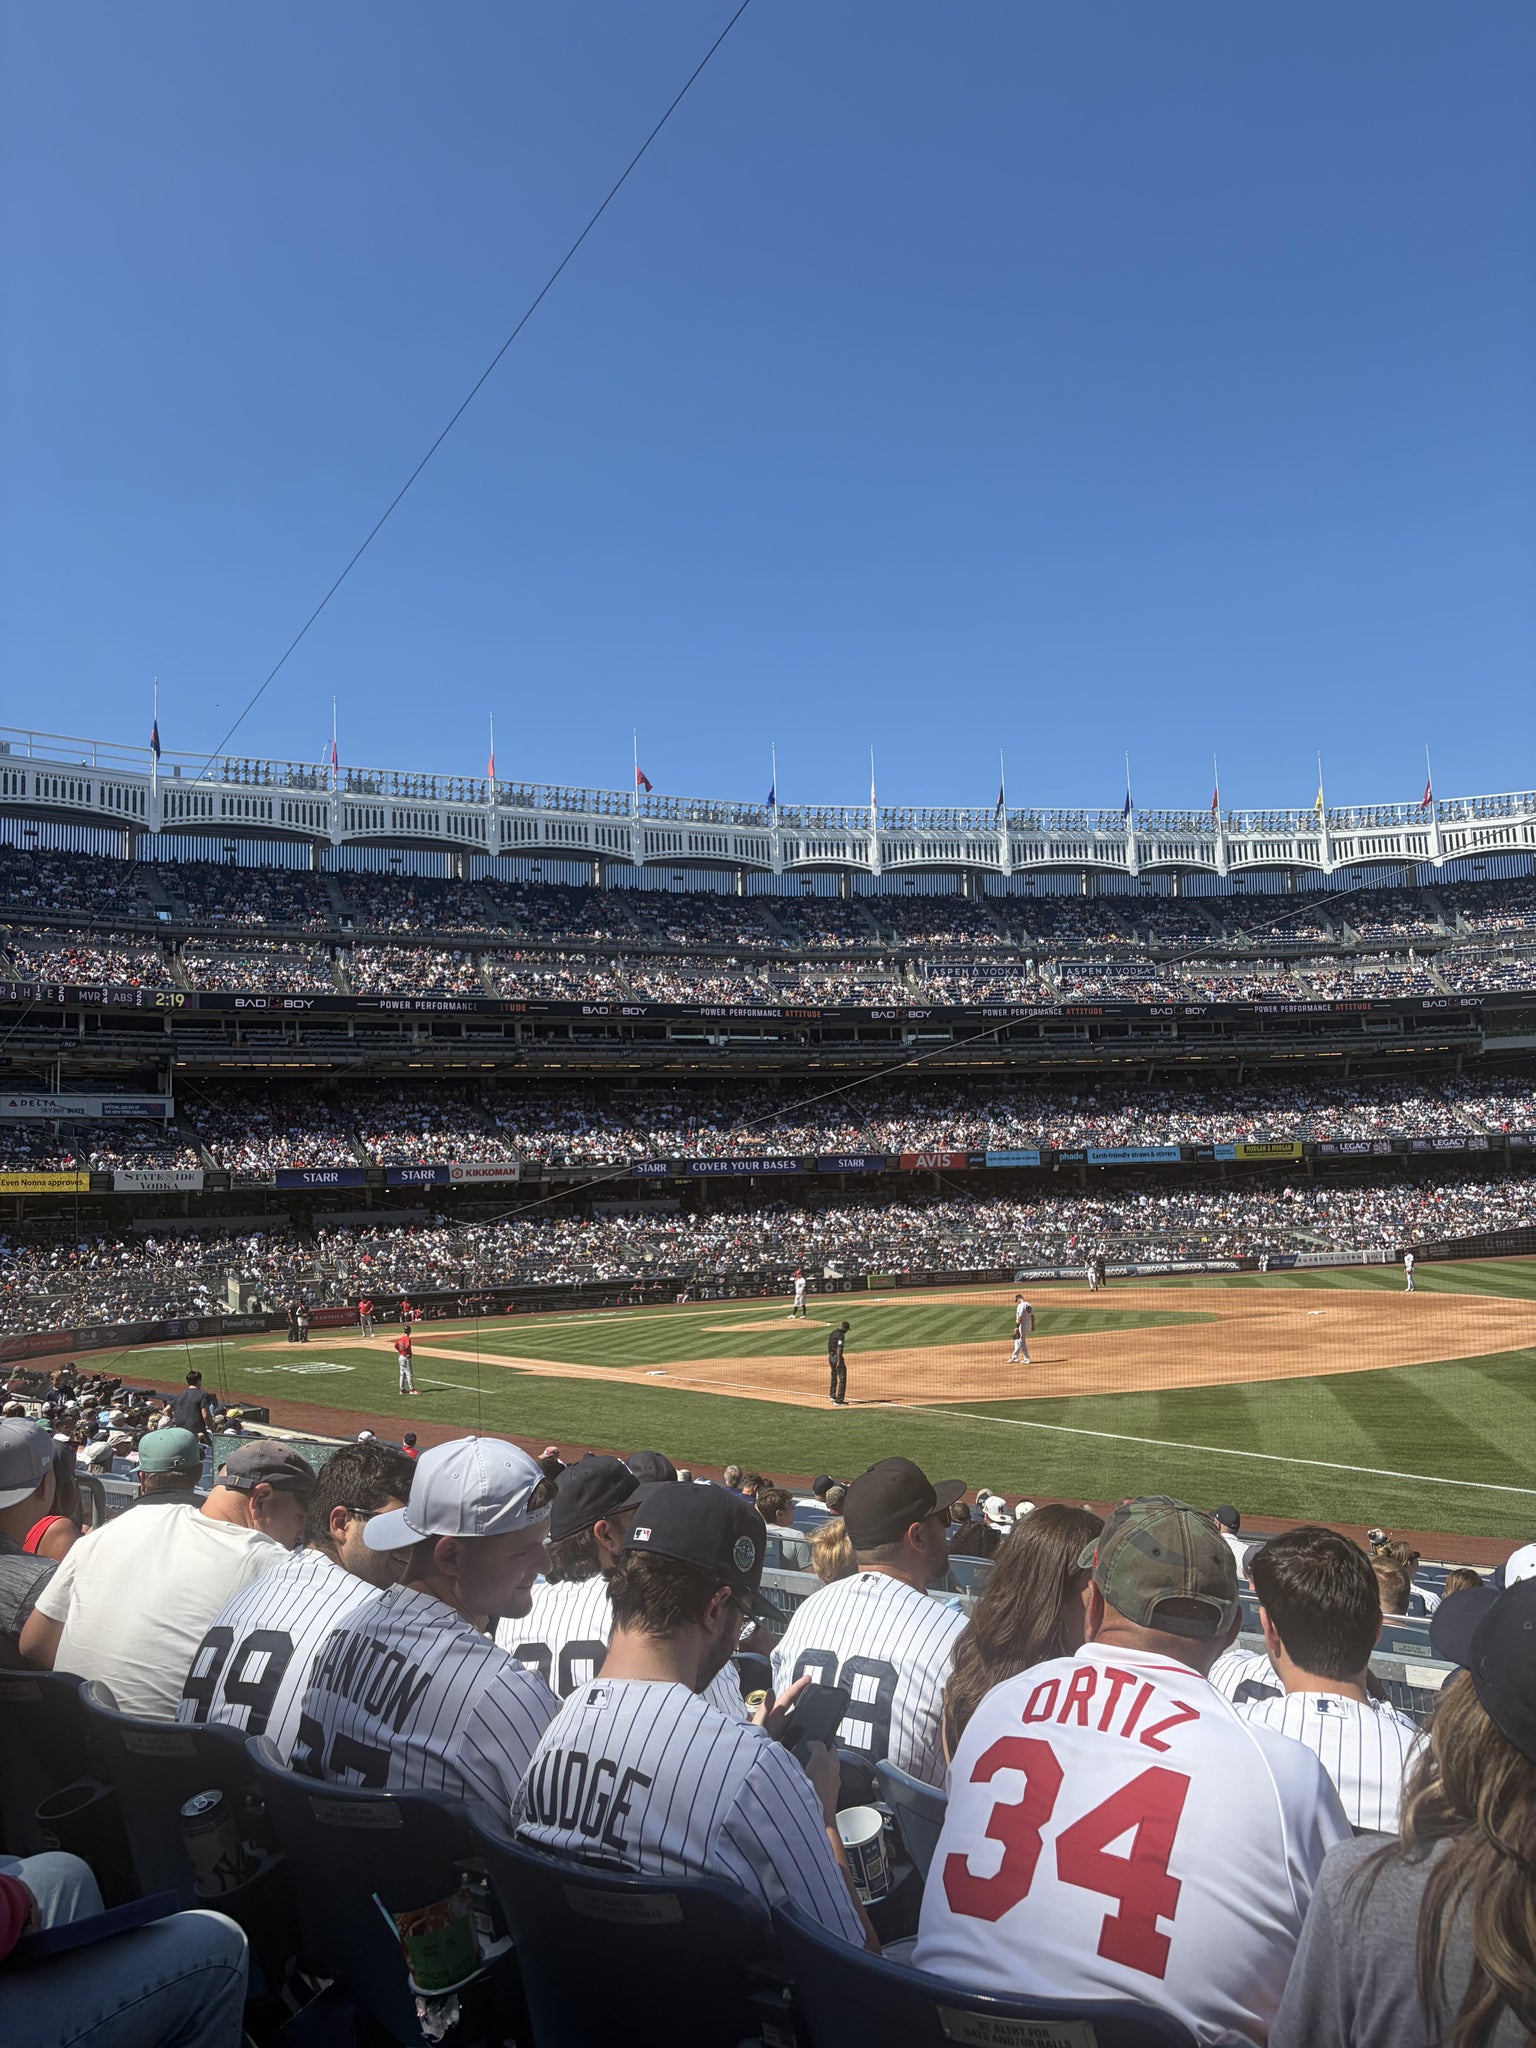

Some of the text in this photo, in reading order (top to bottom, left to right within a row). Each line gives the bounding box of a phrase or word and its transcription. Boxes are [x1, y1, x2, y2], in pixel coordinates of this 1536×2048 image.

[932, 967, 1019, 976] ASPEN VODKA
[1066, 967, 1150, 976] ASPEN VODKA
[23, 988, 31, 997] H
[47, 989, 53, 998] E
[79, 991, 100, 1001] MVR
[113, 992, 133, 1003] ABS
[155, 993, 185, 1007] 2:19
[235, 998, 315, 1009] BAD BOY
[1335, 1002, 1373, 1011] ATTITUDE
[1422, 998, 1485, 1008] BAD BOY
[582, 1006, 648, 1015] BAD BOY
[784, 1010, 822, 1018] ATTITUDE
[871, 1010, 932, 1019] BAD BOY
[1066, 1007, 1103, 1015] ATTITUDE
[1150, 1007, 1208, 1015] BAD BOY
[20, 1099, 56, 1107] DELTA
[1340, 1142, 1371, 1151] LEGACY
[1432, 1138, 1466, 1147] LEGACY
[1246, 1145, 1267, 1153] MORGAN
[1271, 1144, 1292, 1152] MORGAN
[915, 1154, 951, 1168] AVIS
[1059, 1152, 1084, 1163] phade
[1092, 1152, 1130, 1160] Earth-friendly
[637, 1163, 667, 1173] STARR
[692, 1160, 797, 1171] COVER YOUR BASES
[838, 1158, 865, 1168] STARR
[303, 1172, 339, 1183] STARR
[401, 1169, 435, 1180] STARR
[465, 1167, 516, 1178] KIKKOMAN
[21, 1179, 46, 1187] Nonna
[47, 1179, 85, 1188] approves.
[140, 1182, 179, 1190] VODKA
[244, 1318, 265, 1328] Spring
[183, 1626, 295, 1736] 99
[1021, 1664, 1201, 1753] ORTIZ
[525, 1748, 653, 1852] JUDGE
[942, 1735, 1192, 1980] 34
[994, 2024, 1026, 2037] ALERT
[1029, 2027, 1050, 2038] FOR
